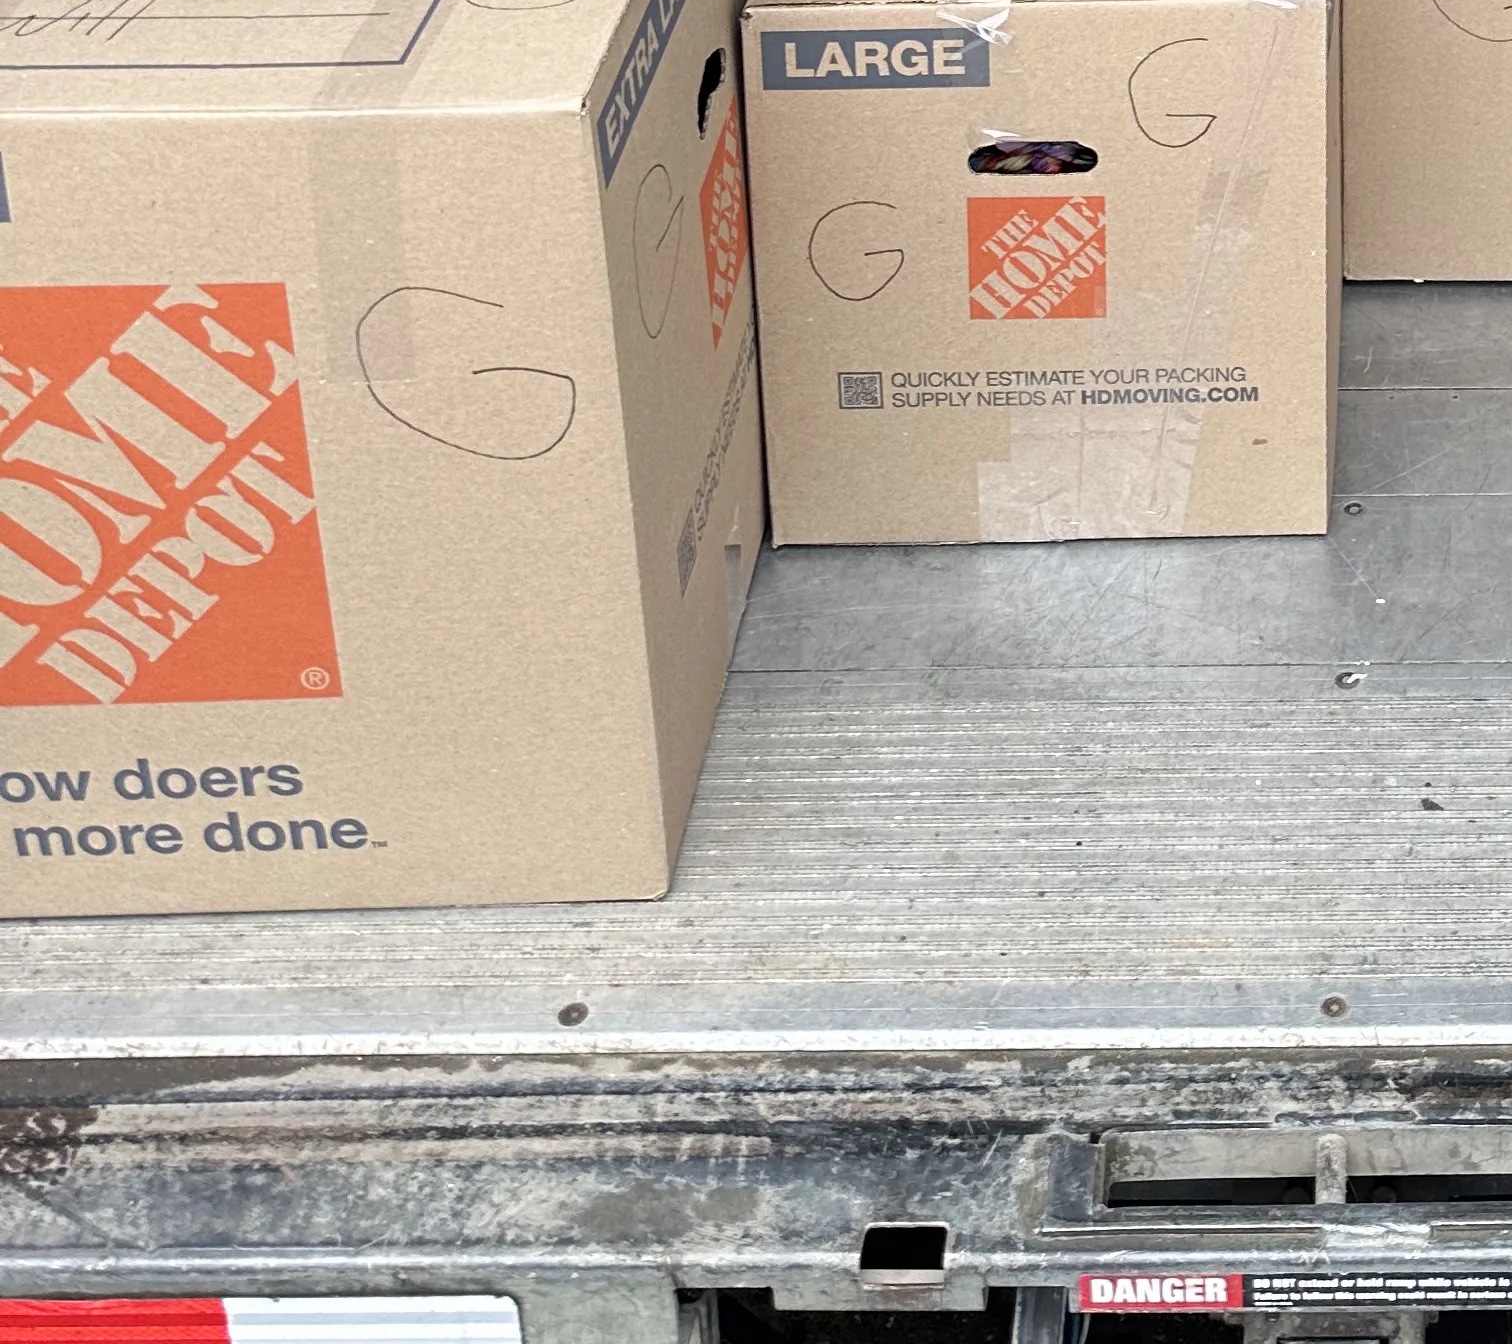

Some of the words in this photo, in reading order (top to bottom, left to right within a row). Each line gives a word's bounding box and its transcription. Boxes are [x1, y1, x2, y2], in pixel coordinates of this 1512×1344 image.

[604, 29, 660, 161] EXTRA
[785, 39, 967, 78] LARGE
[1128, 38, 1217, 148] G
[808, 200, 905, 301] G
[968, 196, 1107, 319] HOME
[981, 209, 1039, 260] THE
[1023, 241, 1107, 319] DEPOT
[355, 287, 577, 461] G
[891, 371, 981, 389] QUICKLY
[986, 370, 1085, 387] ESTIMATE
[1089, 368, 1150, 385] YOUR
[1155, 367, 1246, 383] PACKING
[891, 391, 971, 408] SUPPLY
[977, 390, 1046, 407] NEEDS
[1051, 389, 1076, 405] AT
[1081, 386, 1260, 405] HDMOVING.COM
[0, 283, 299, 668] OME
[36, 441, 316, 704] DEPOT
[0, 771, 91, 803] ow
[113, 758, 305, 800] doers
[13, 823, 184, 857] more
[1090, 1278, 1228, 1303] DANGER
